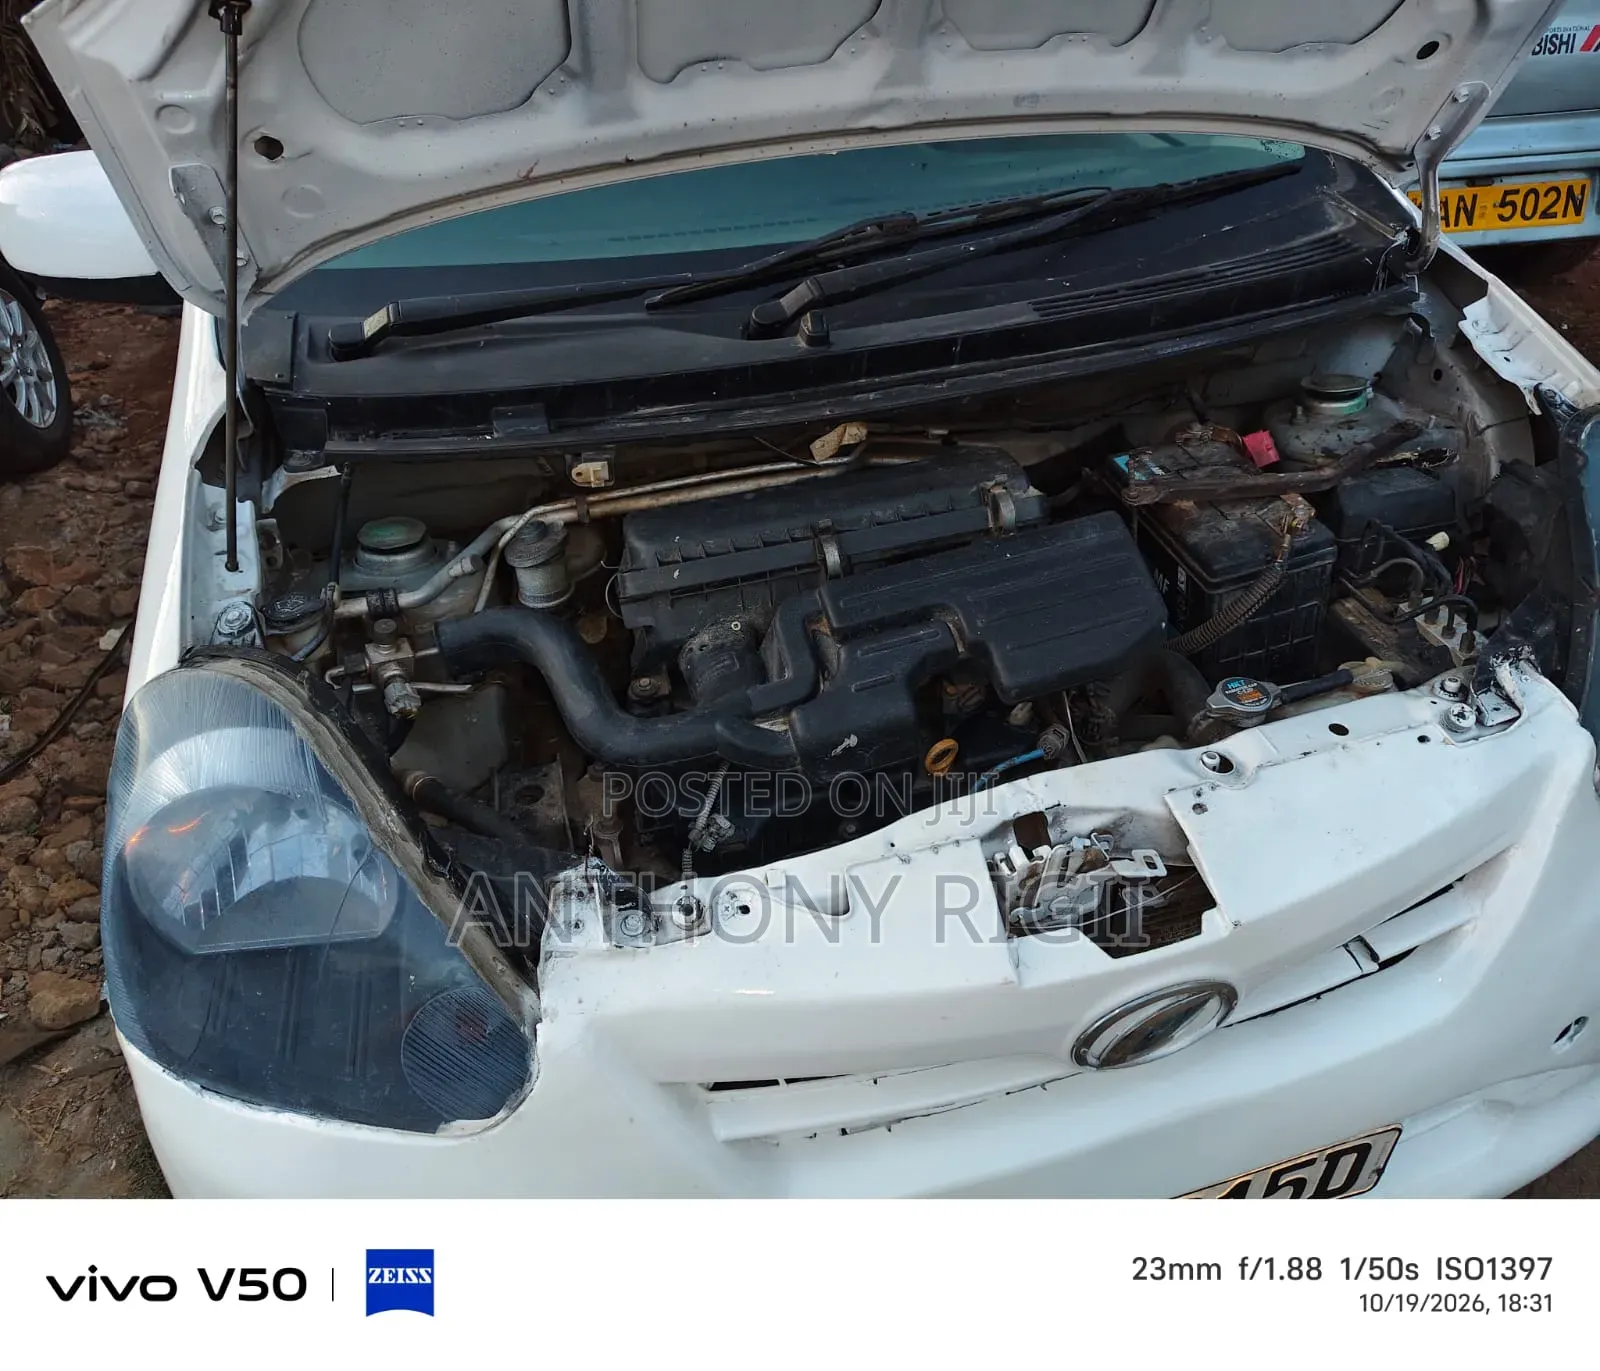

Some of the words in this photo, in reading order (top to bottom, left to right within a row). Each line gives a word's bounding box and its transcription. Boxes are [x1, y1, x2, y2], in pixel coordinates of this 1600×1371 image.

[1531, 33, 1577, 56] BISHI
[1413, 193, 1478, 229] AN
[1497, 184, 1587, 222] 502N
